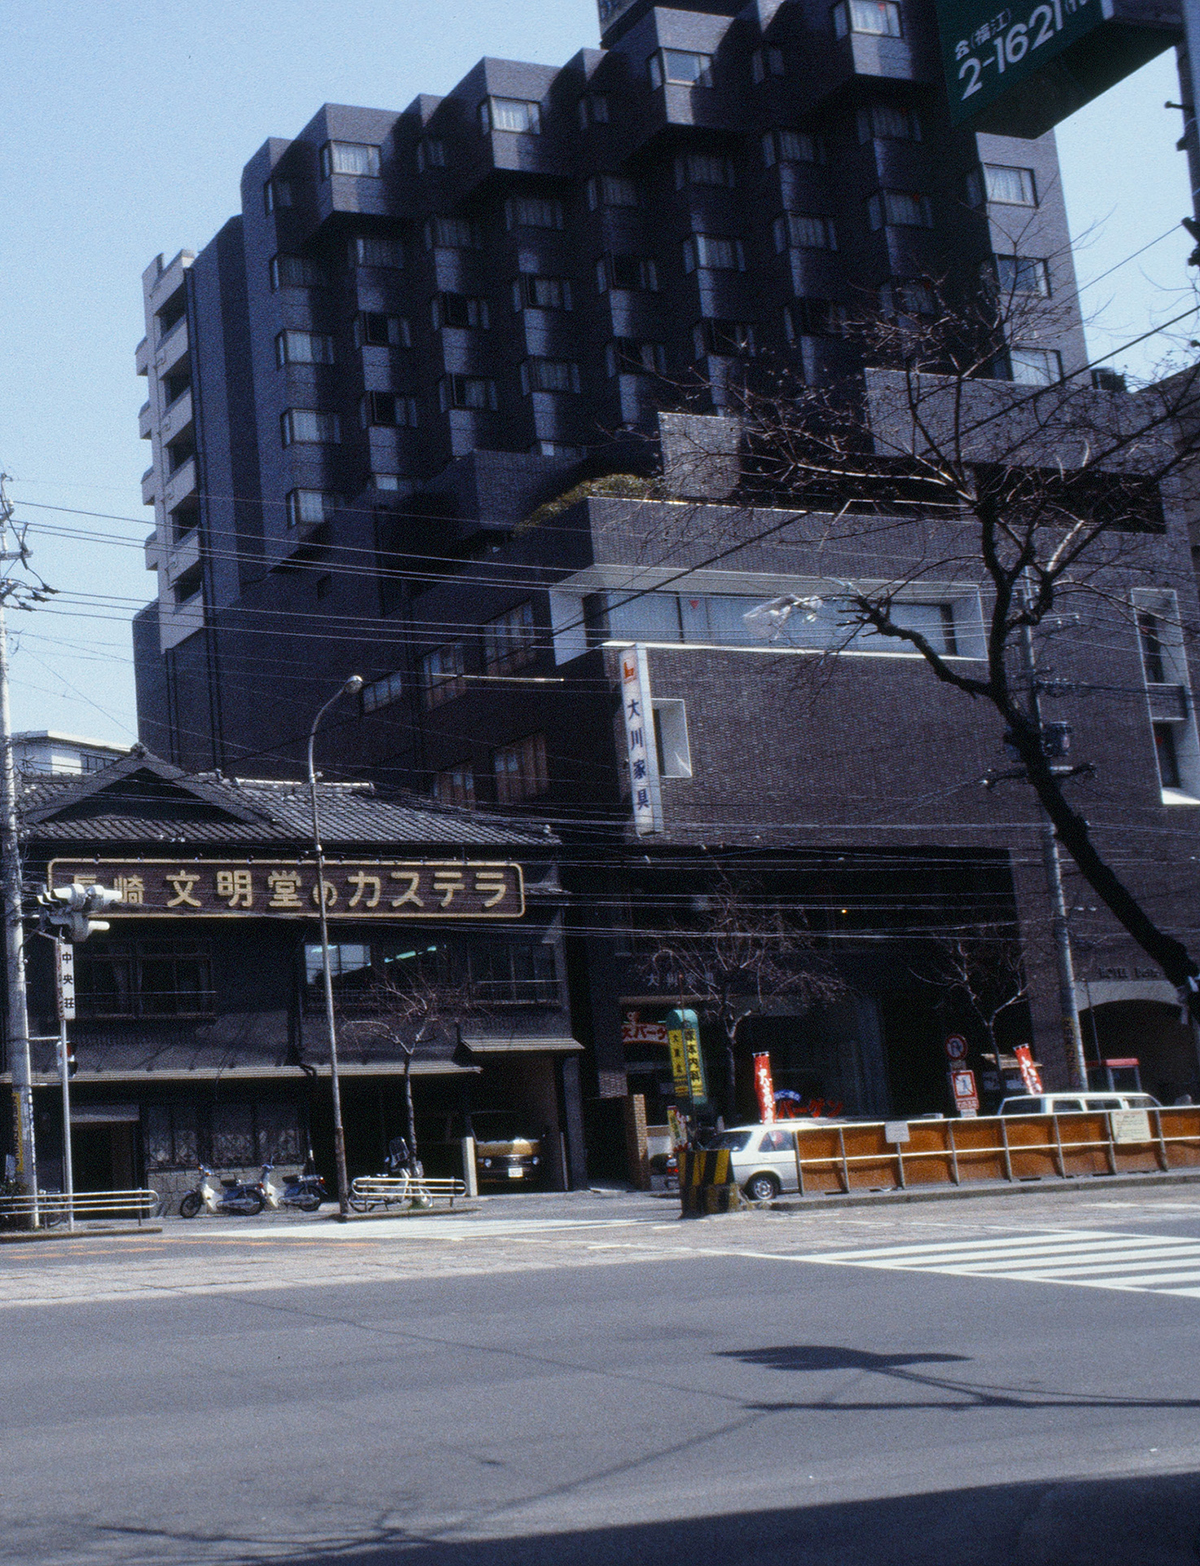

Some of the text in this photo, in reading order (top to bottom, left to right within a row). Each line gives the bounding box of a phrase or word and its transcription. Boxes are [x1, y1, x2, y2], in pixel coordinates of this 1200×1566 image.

[627, 698, 650, 812] 大川家具
[62, 951, 75, 1009] 中央荘
[776, 1098, 844, 1119] バーゲン
